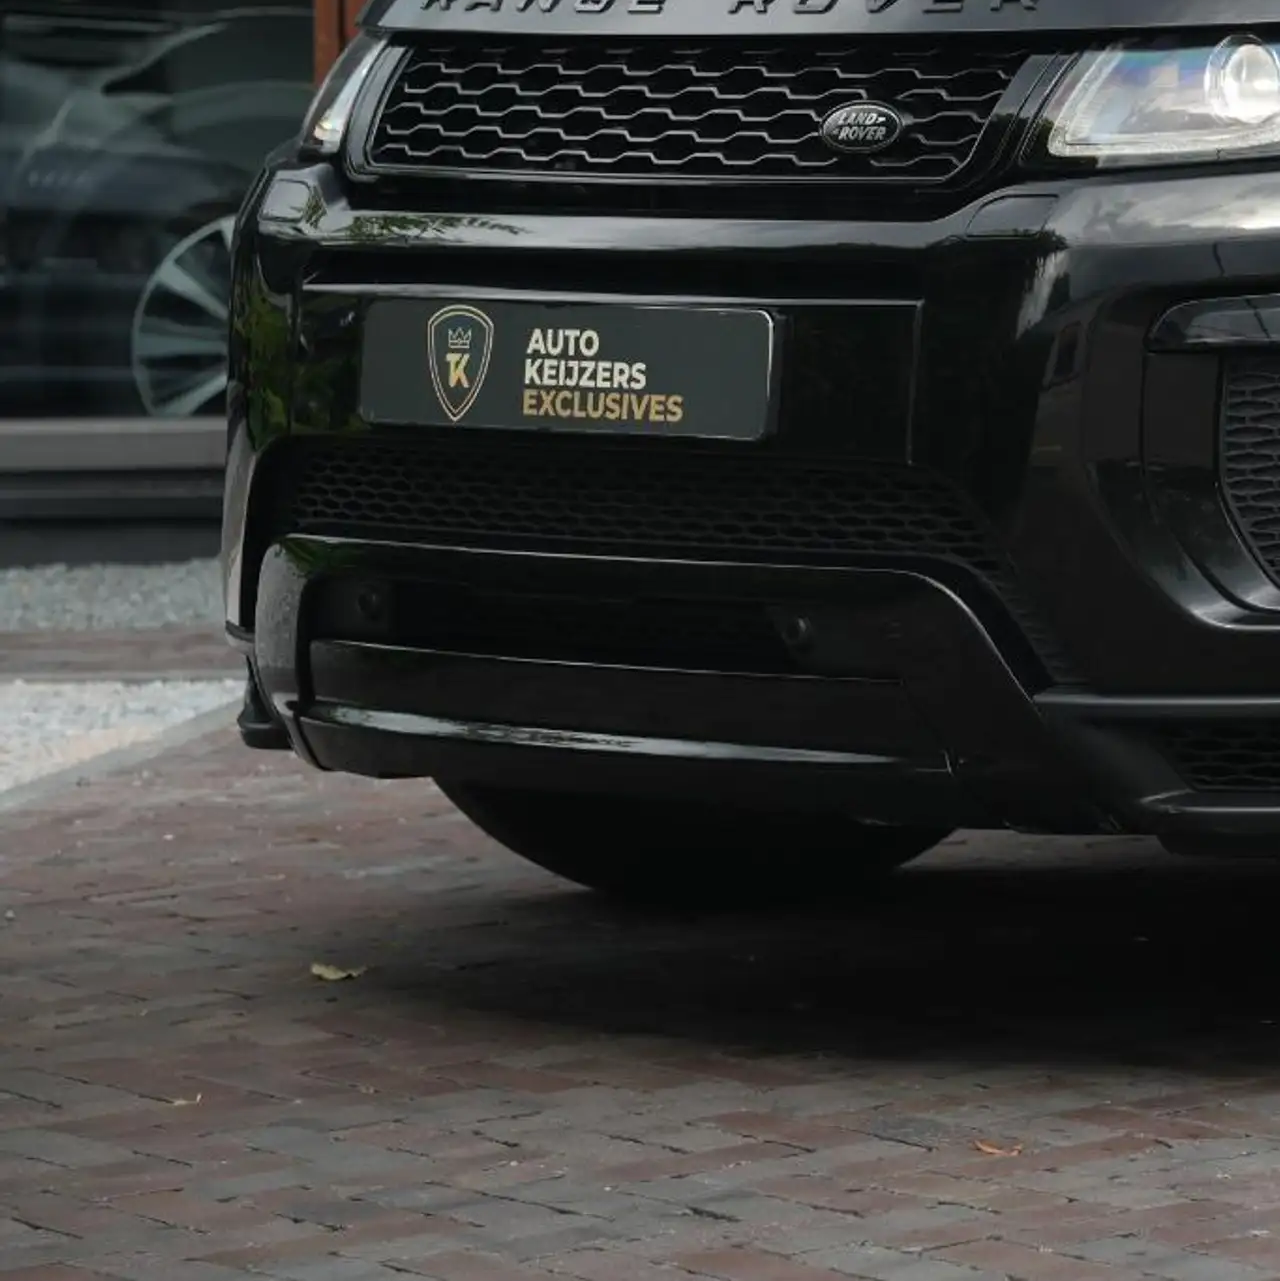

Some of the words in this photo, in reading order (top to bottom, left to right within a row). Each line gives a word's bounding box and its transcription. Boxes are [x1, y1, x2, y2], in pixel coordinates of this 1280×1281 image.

[838, 126, 886, 141] ROVER
[527, 328, 600, 356] AUTO
[524, 359, 646, 389] KEIJZERS
[523, 390, 684, 421] EXCLUSIVES
